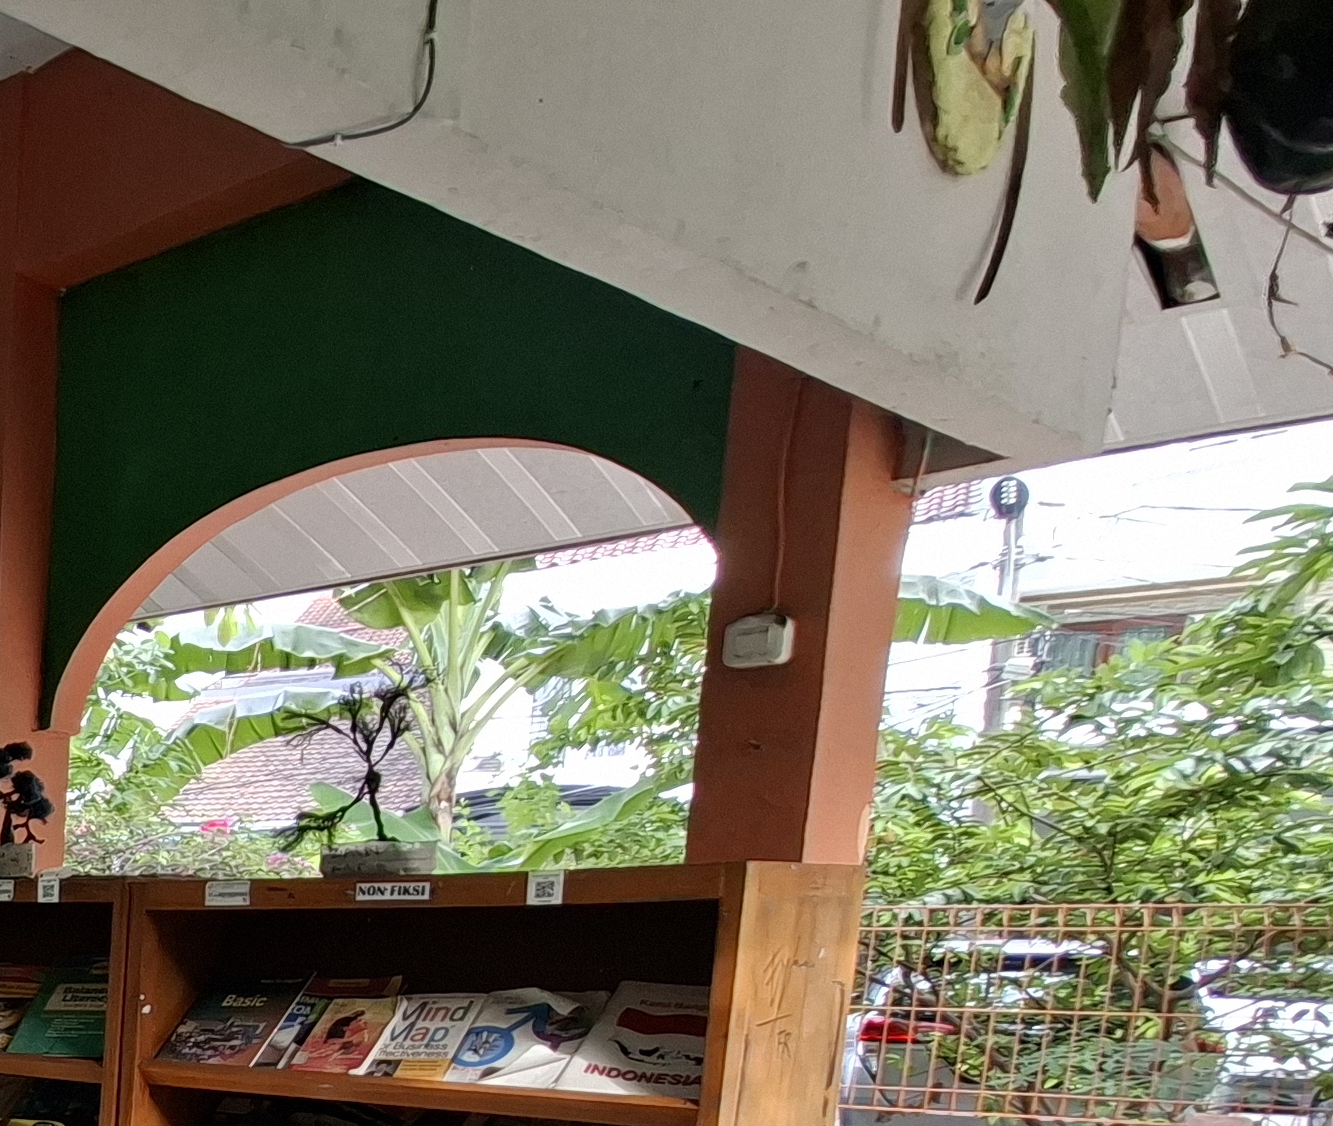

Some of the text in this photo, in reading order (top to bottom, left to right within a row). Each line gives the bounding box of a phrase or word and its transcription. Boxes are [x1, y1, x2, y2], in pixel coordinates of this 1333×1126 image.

[357, 885, 426, 897] NON FIKSI
[222, 995, 267, 1007] Basic
[401, 1001, 474, 1022] Mind
[389, 1023, 450, 1044] Map
[583, 1063, 703, 1086] INDONESIA
